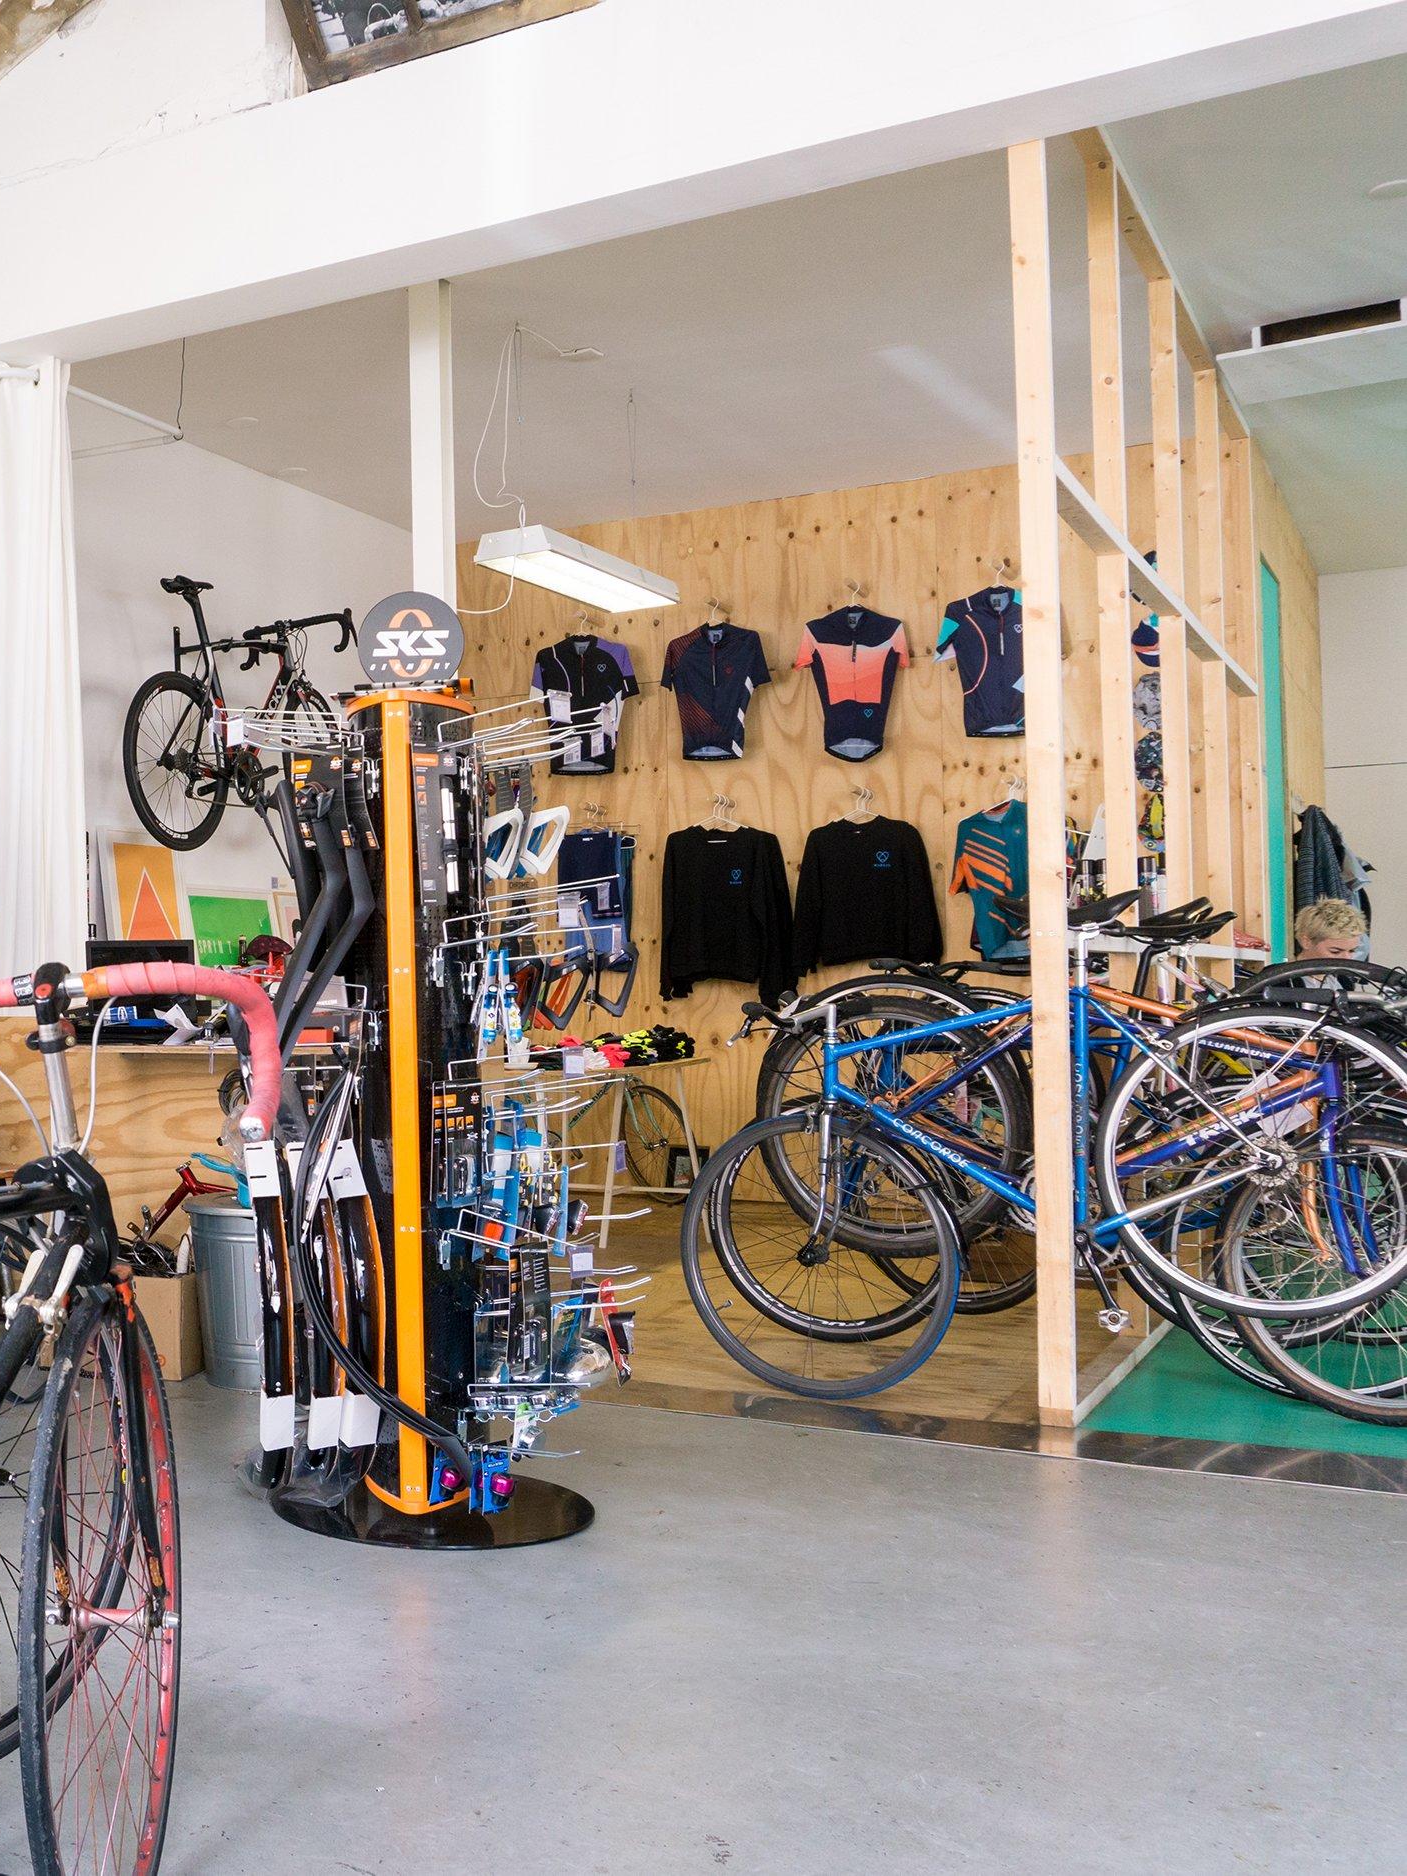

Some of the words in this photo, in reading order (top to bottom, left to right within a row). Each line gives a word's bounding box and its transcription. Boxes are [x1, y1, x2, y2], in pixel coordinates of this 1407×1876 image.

[372, 630, 450, 657] SKS
[369, 662, 451, 671] GERMANY
[1198, 1038, 1273, 1059] ALUMINUM
[1179, 1107, 1264, 1147] TREK
[893, 1117, 969, 1169] CONCORDE
